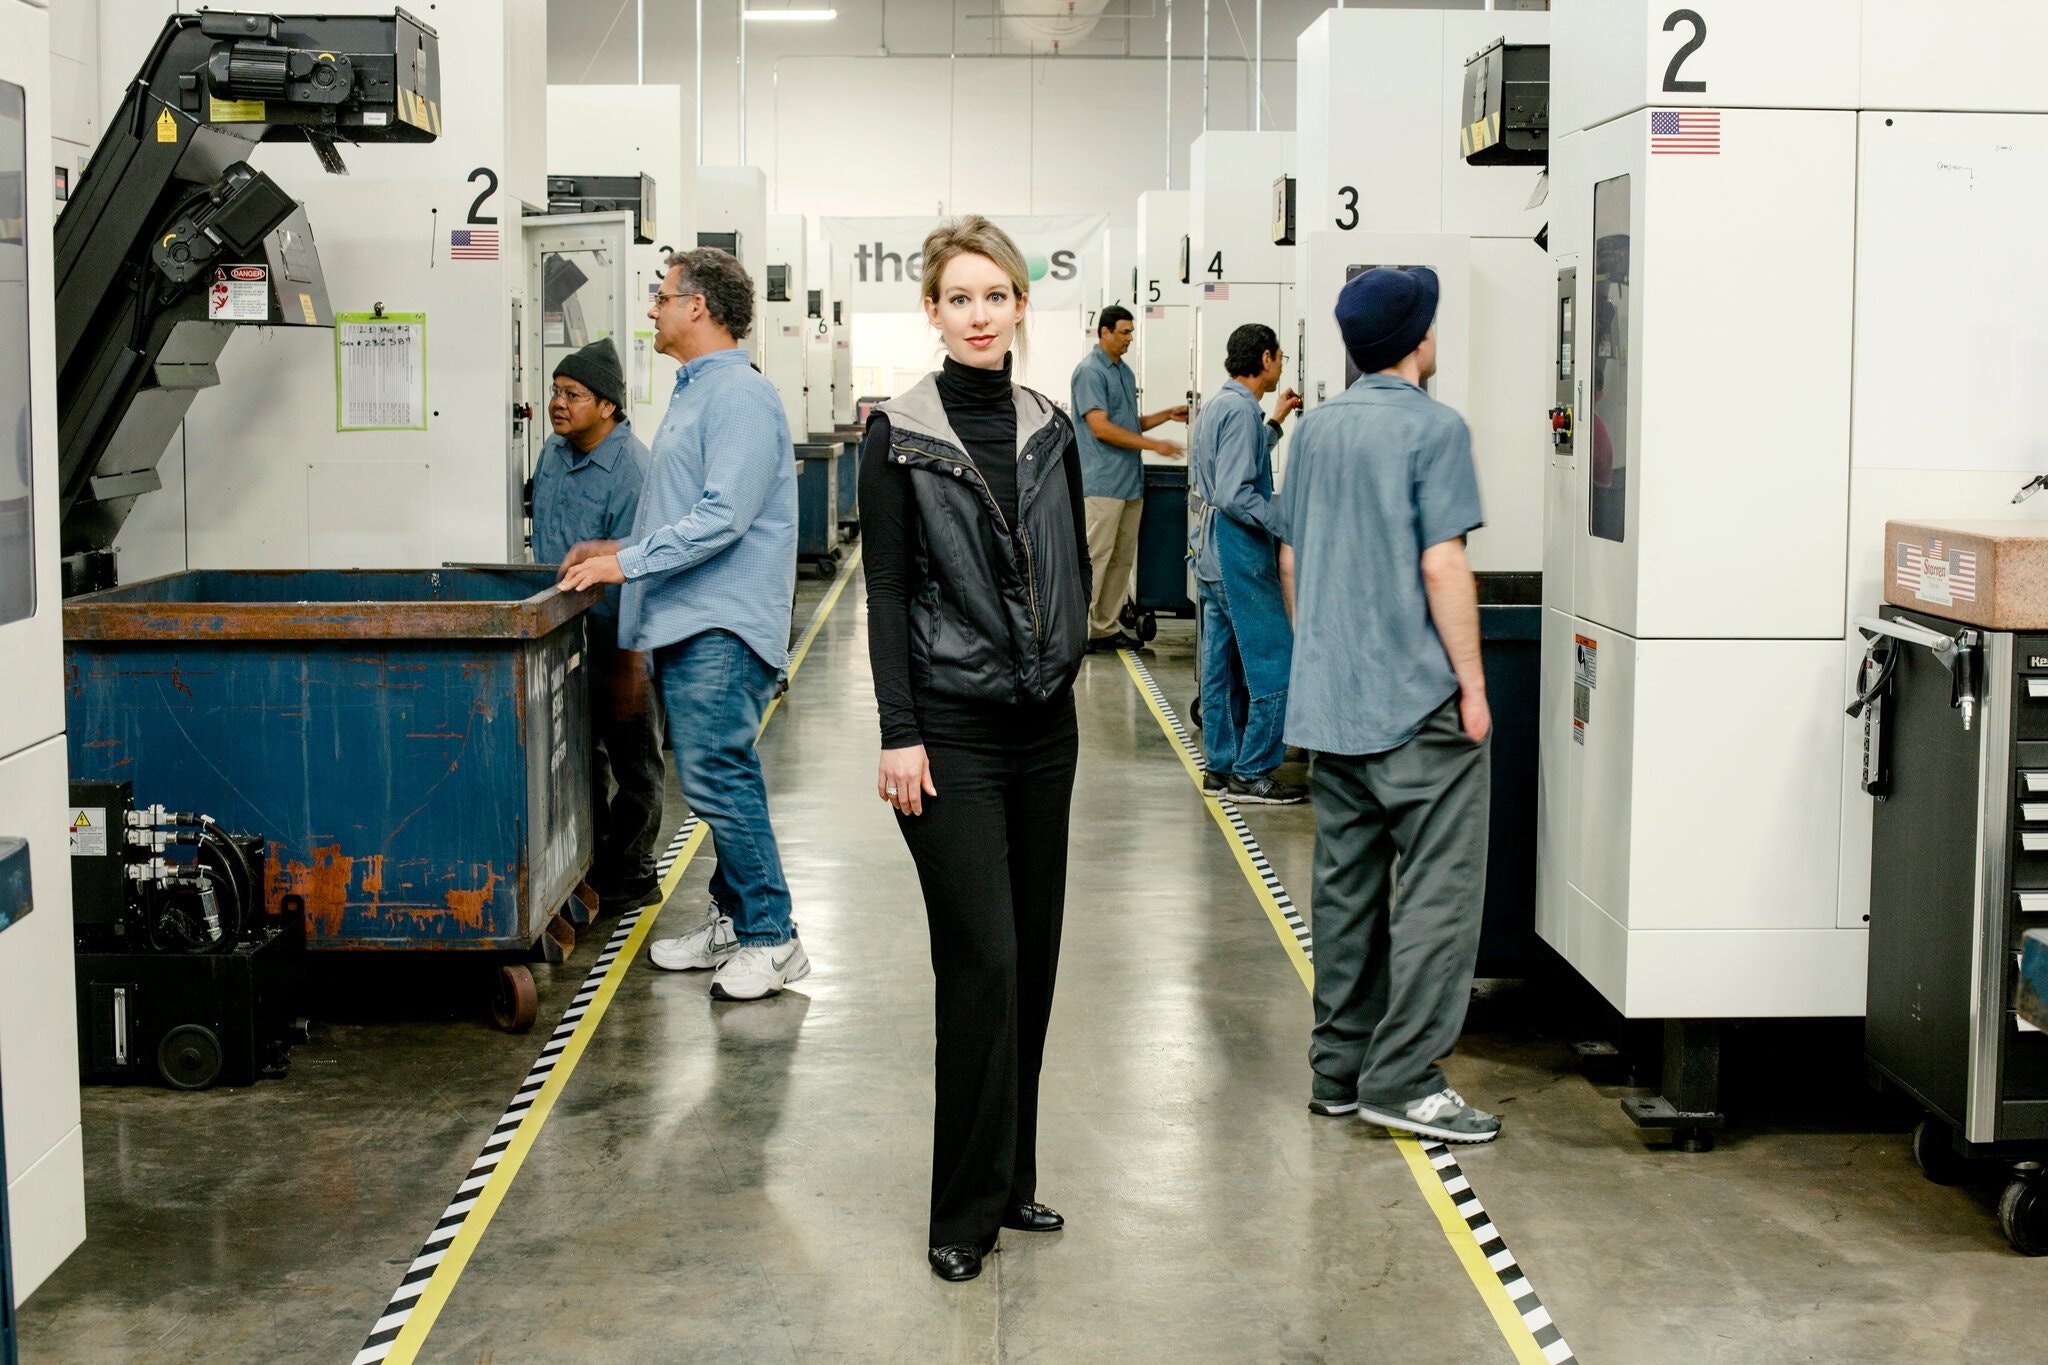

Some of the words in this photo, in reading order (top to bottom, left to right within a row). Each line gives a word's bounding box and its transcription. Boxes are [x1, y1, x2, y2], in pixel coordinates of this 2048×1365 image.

[1662, 9, 1707, 93] 2
[467, 167, 498, 225] 2
[1335, 185, 1360, 231] 3
[233, 270, 263, 278] DANGER
[1207, 250, 1224, 280] 4
[1148, 279, 1161, 303] 5
[818, 318, 828, 335] 6
[1087, 311, 1096, 327] 7
